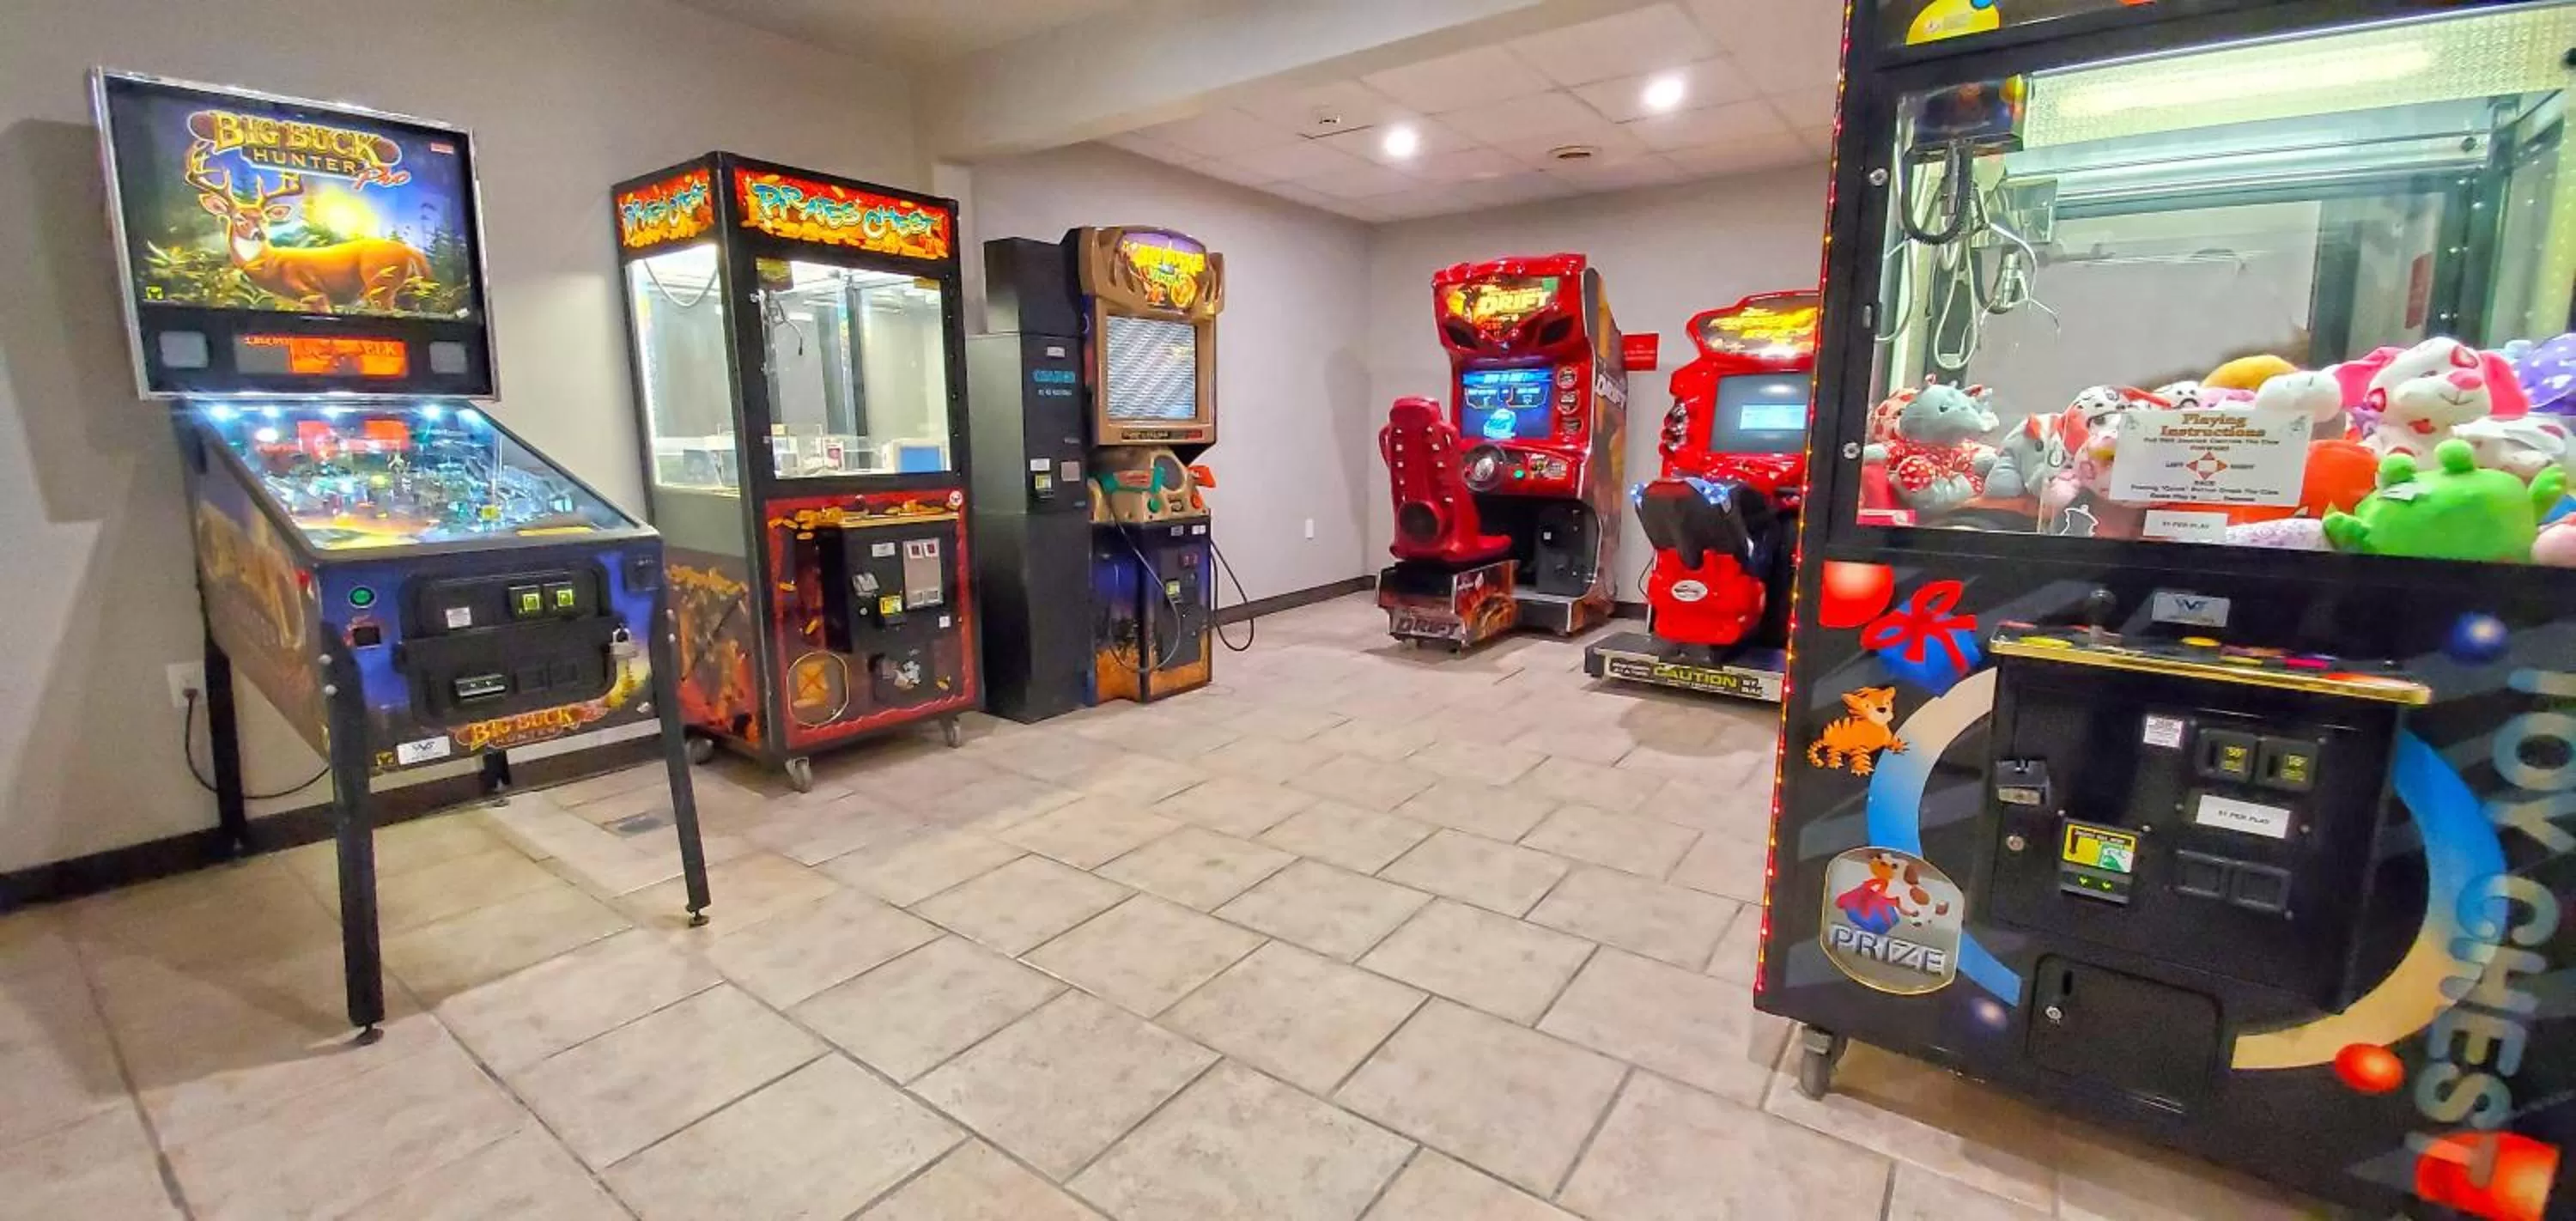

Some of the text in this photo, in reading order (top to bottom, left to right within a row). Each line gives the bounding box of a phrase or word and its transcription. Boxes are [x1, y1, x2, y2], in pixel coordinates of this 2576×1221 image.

[215, 111, 386, 167] BIG BUCK
[254, 149, 356, 174] HUNTER
[752, 182, 938, 240] PIRATES CHEST
[1475, 289, 1552, 316] DRIFT
[2160, 424, 2266, 438] Instructions
[2182, 413, 2247, 428] Playing
[1653, 664, 1738, 688] CAUTION
[470, 718, 512, 750] BIG
[515, 708, 574, 732] BUCK
[1831, 922, 1947, 977] PRIZE
[2405, 874, 2561, 1188] CHEST
